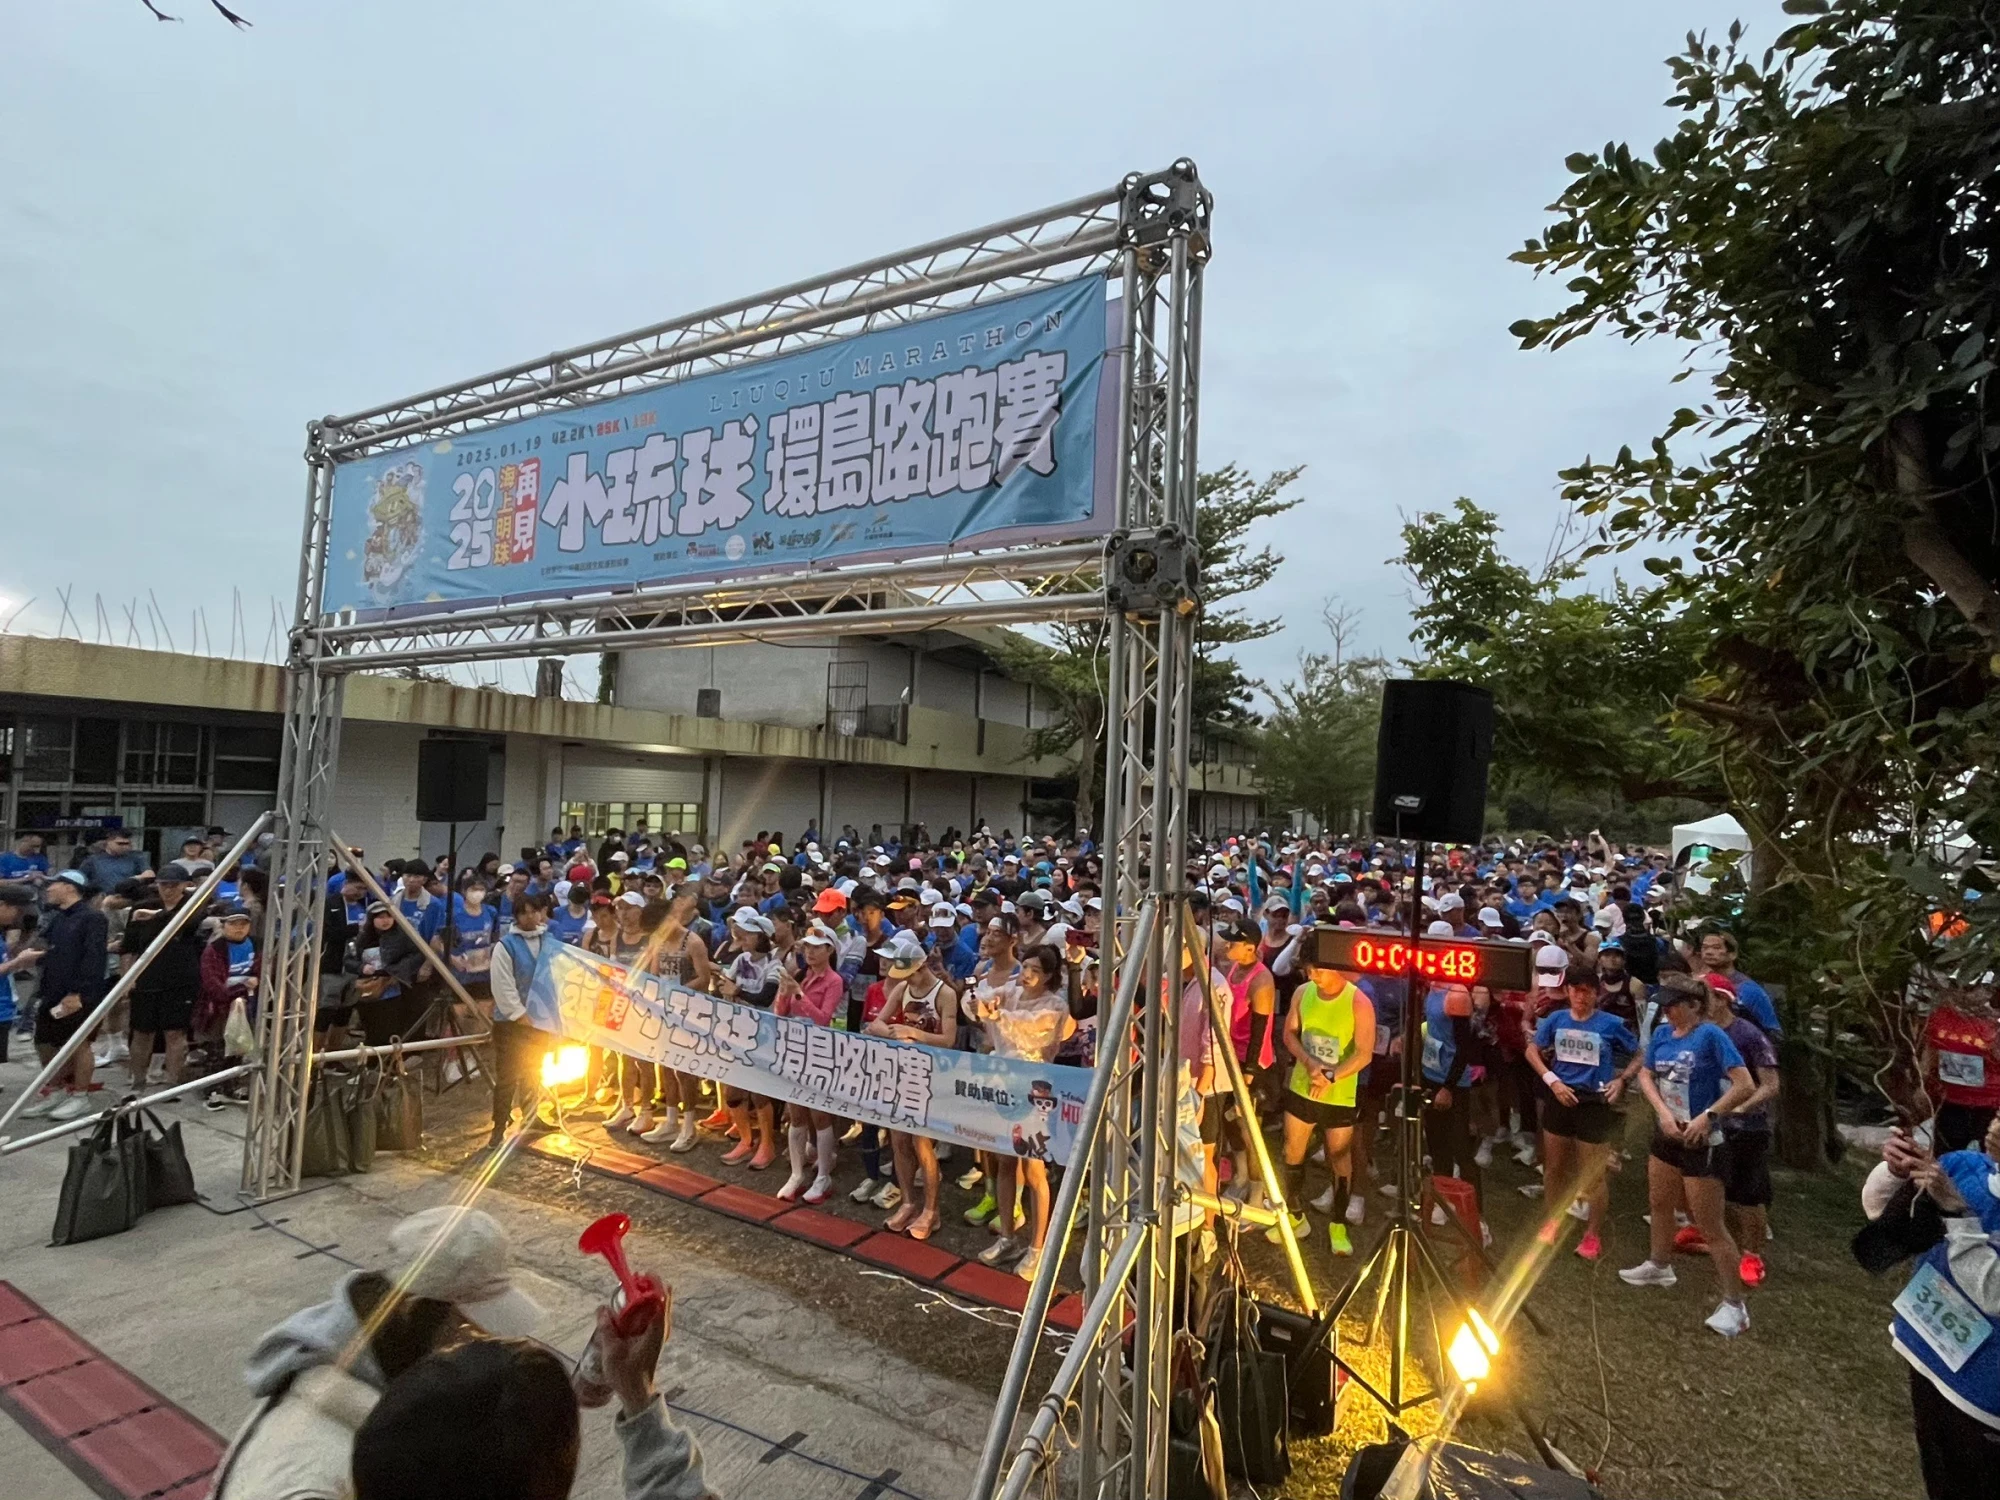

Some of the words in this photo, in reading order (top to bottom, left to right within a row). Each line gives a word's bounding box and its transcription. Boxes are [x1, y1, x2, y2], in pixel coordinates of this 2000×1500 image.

[709, 368, 836, 413] LIUQIU
[854, 309, 1065, 377] MARATHON
[457, 436, 542, 467] 2025.01.19
[541, 413, 759, 553] 小琉球
[763, 349, 1068, 519] 環島路跑賽
[449, 466, 495, 521] 20
[446, 519, 493, 571] 25
[647, 1046, 729, 1079] LIUQIU
[769, 1018, 933, 1128] 環島路跑賽
[1916, 1284, 1972, 1344] 3163
